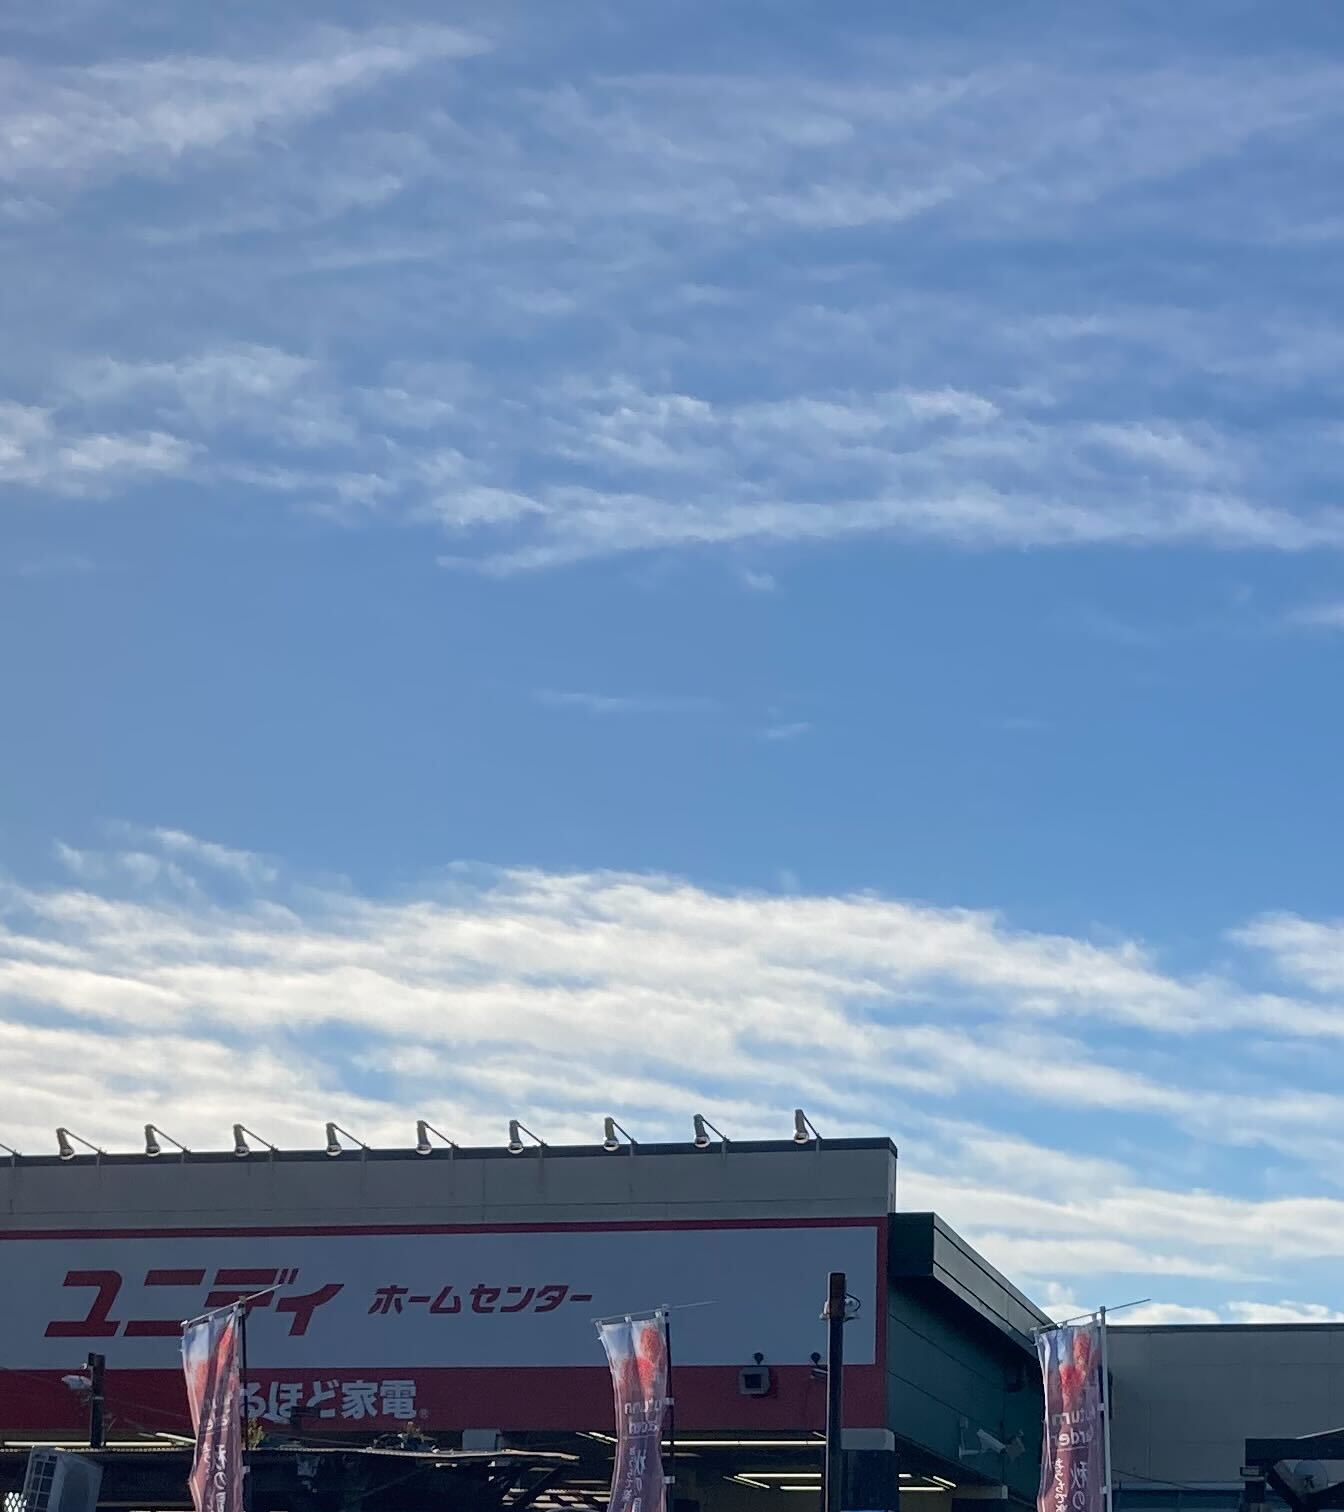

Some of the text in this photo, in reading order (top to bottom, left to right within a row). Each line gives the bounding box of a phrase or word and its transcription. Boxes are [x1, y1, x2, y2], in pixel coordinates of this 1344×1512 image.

[44, 1268, 344, 1338] ユニディ
[368, 1284, 592, 1315] ホームセンター
[240, 1379, 417, 1425] るほど家電
